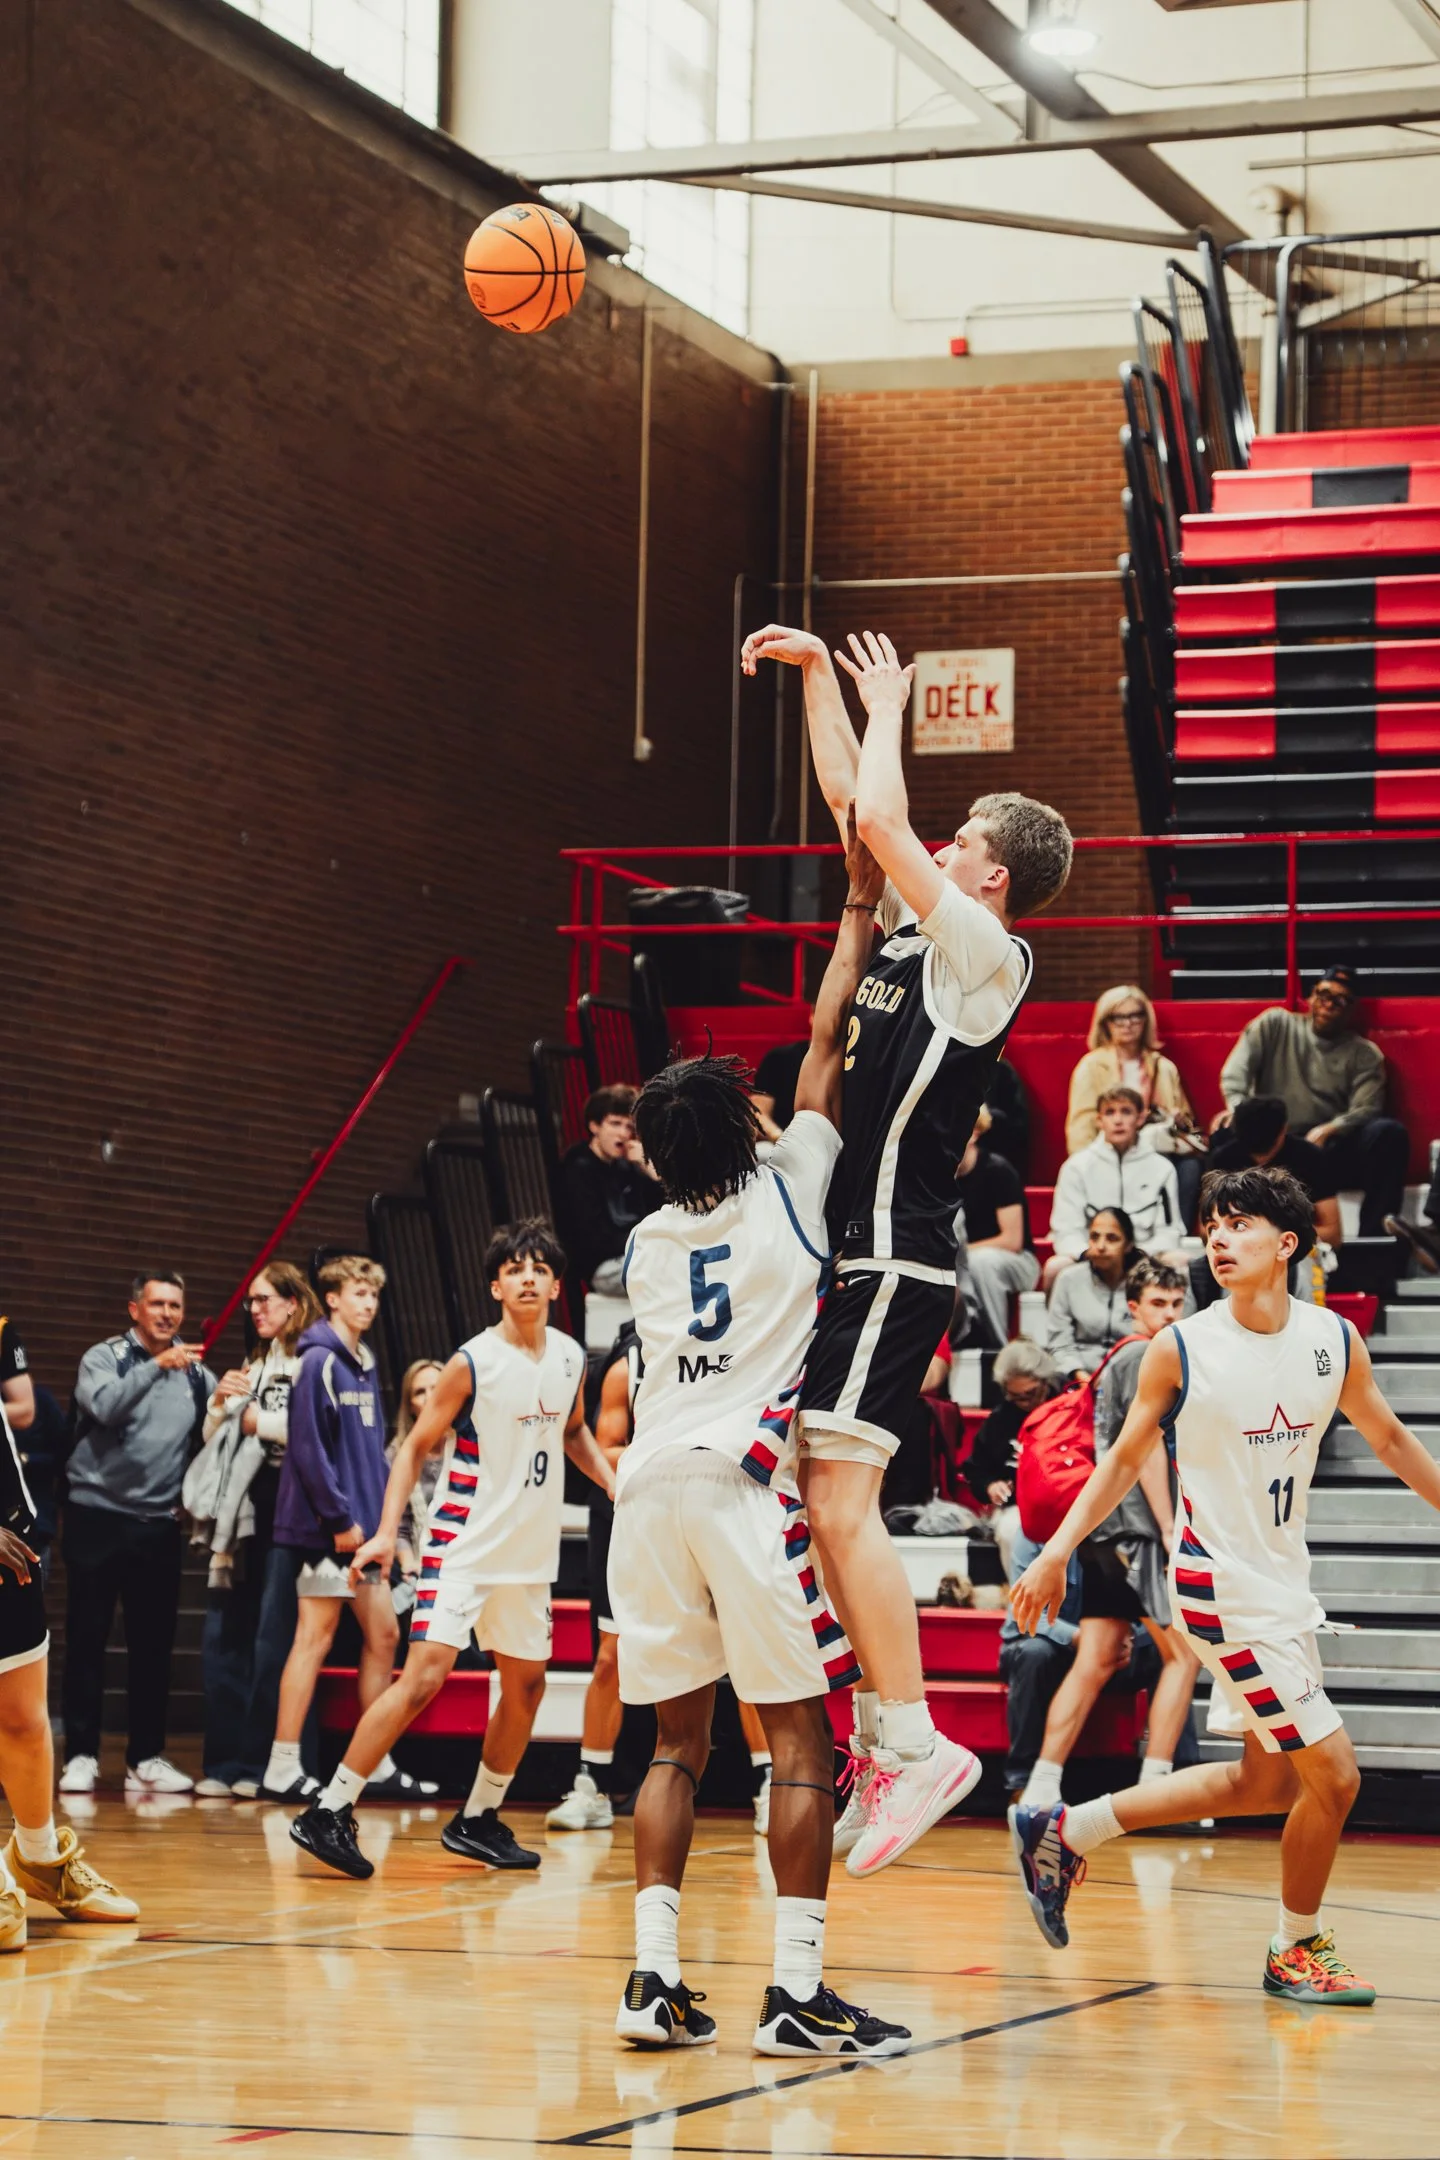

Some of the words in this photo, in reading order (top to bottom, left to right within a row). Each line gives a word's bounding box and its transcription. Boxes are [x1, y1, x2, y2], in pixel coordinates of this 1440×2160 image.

[925, 682, 999, 718] DECK
[856, 976, 905, 1013] GOLD
[688, 1243, 732, 1342] 5
[1248, 1428, 1308, 1445] INSPIRE
[1268, 1476, 1294, 1527] 11
